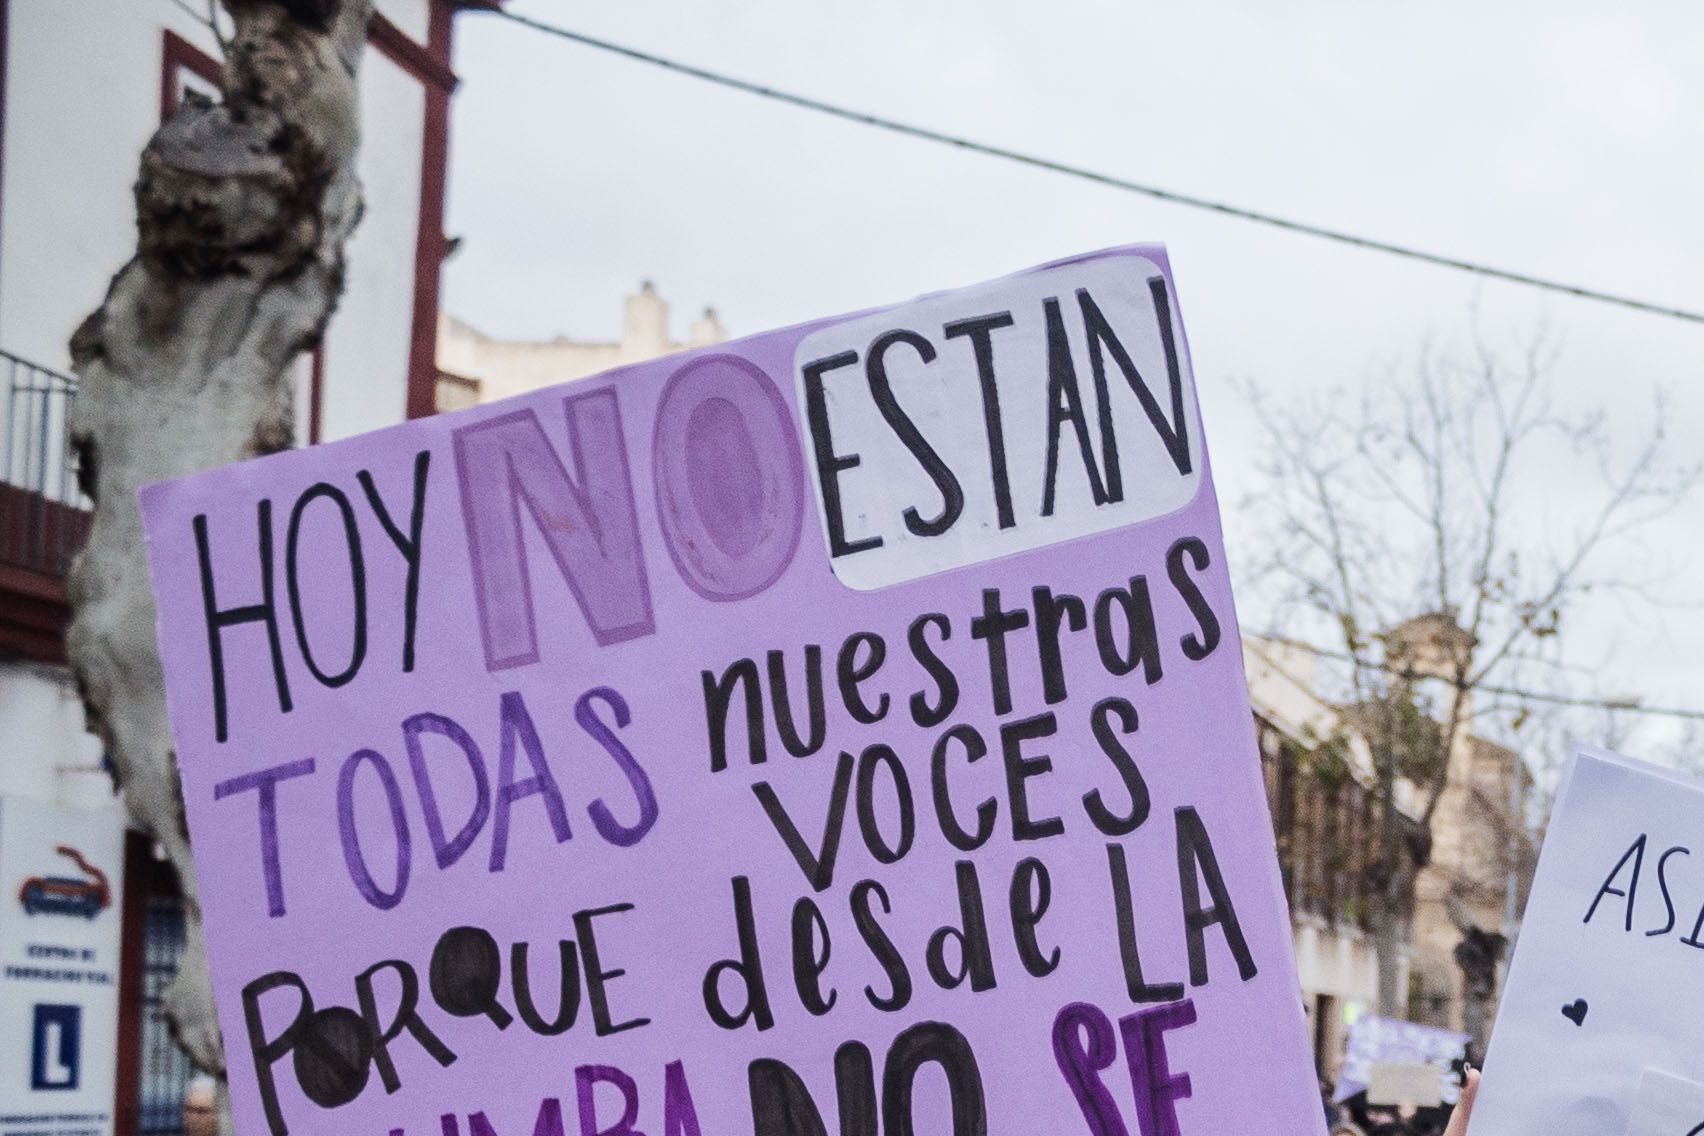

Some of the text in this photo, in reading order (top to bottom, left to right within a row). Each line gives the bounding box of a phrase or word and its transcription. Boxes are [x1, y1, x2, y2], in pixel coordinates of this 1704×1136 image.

[192, 276, 1193, 743] HOY NO ESTAN
[213, 536, 1221, 918] TODAS nuestras
[750, 696, 1151, 893] VOCES
[701, 857, 1062, 1032] desde
[1106, 805, 1258, 1004] LA
